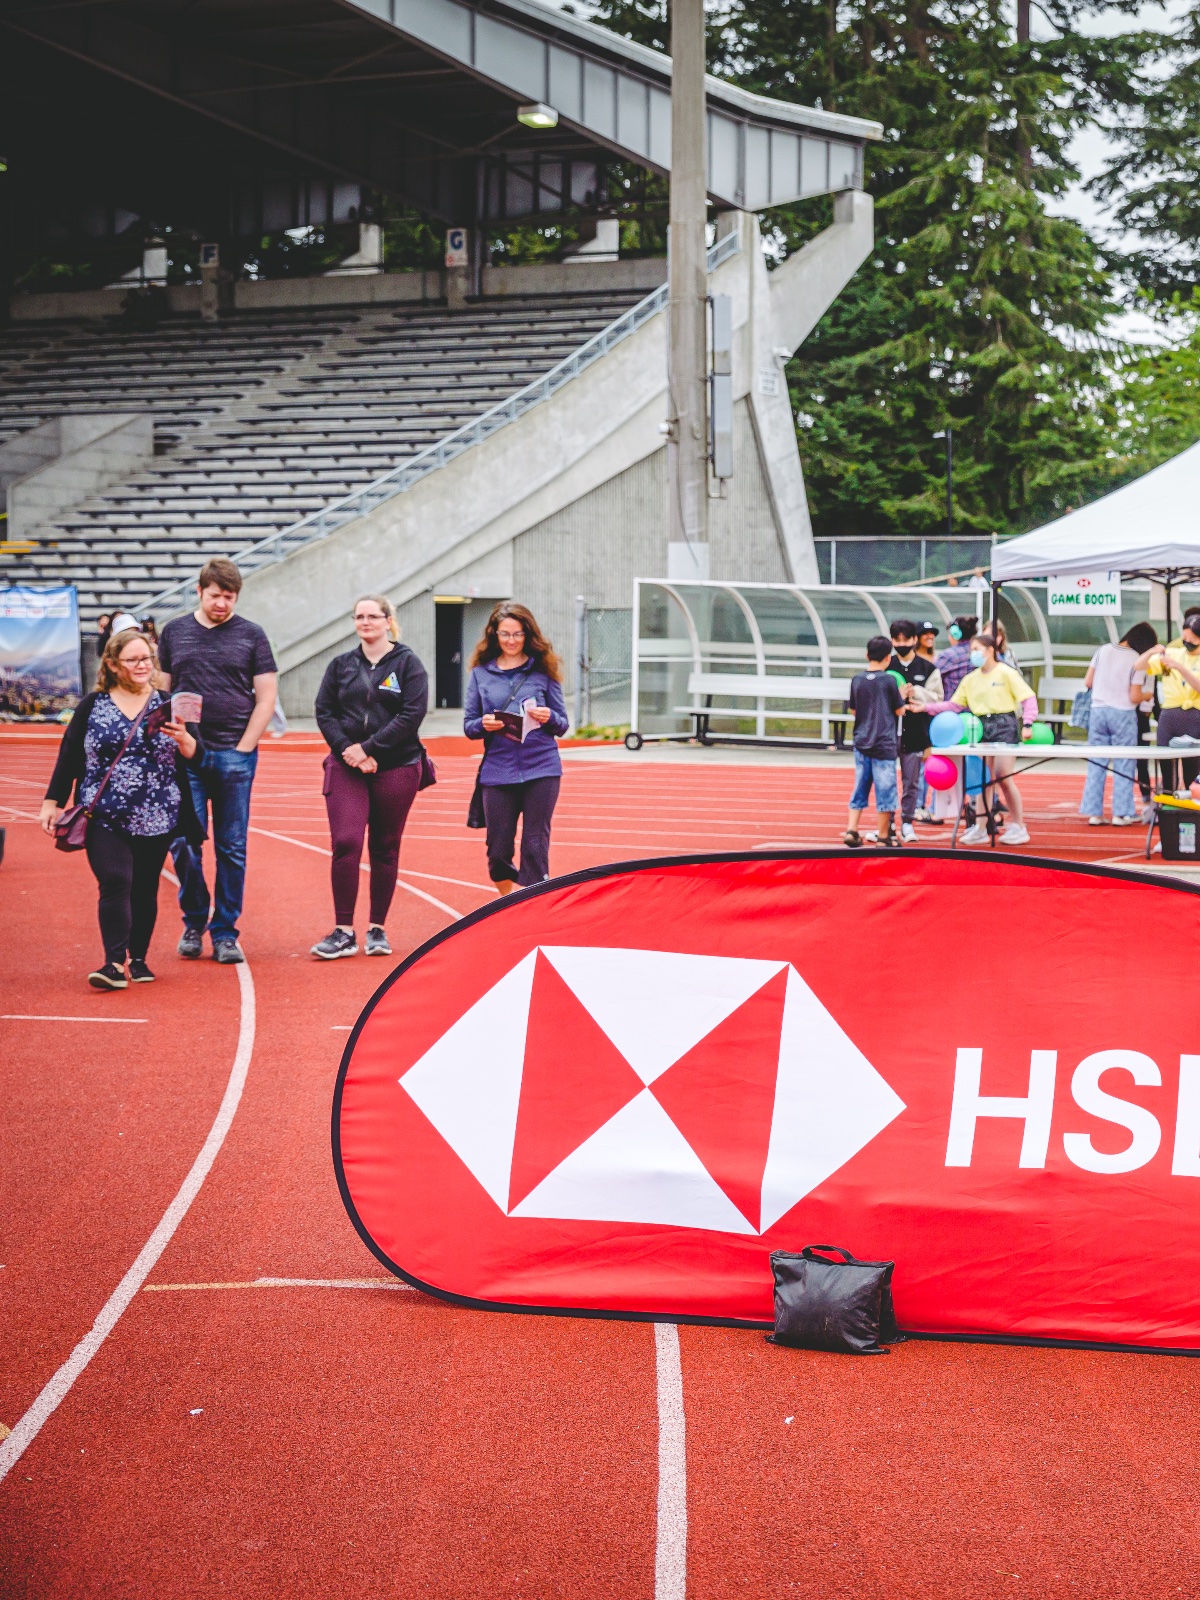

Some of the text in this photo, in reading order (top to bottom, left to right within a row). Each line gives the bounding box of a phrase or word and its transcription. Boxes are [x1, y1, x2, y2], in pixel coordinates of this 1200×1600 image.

[450, 231, 463, 250] G
[203, 245, 216, 263] F
[1051, 593, 1117, 605] GAME BOOTH
